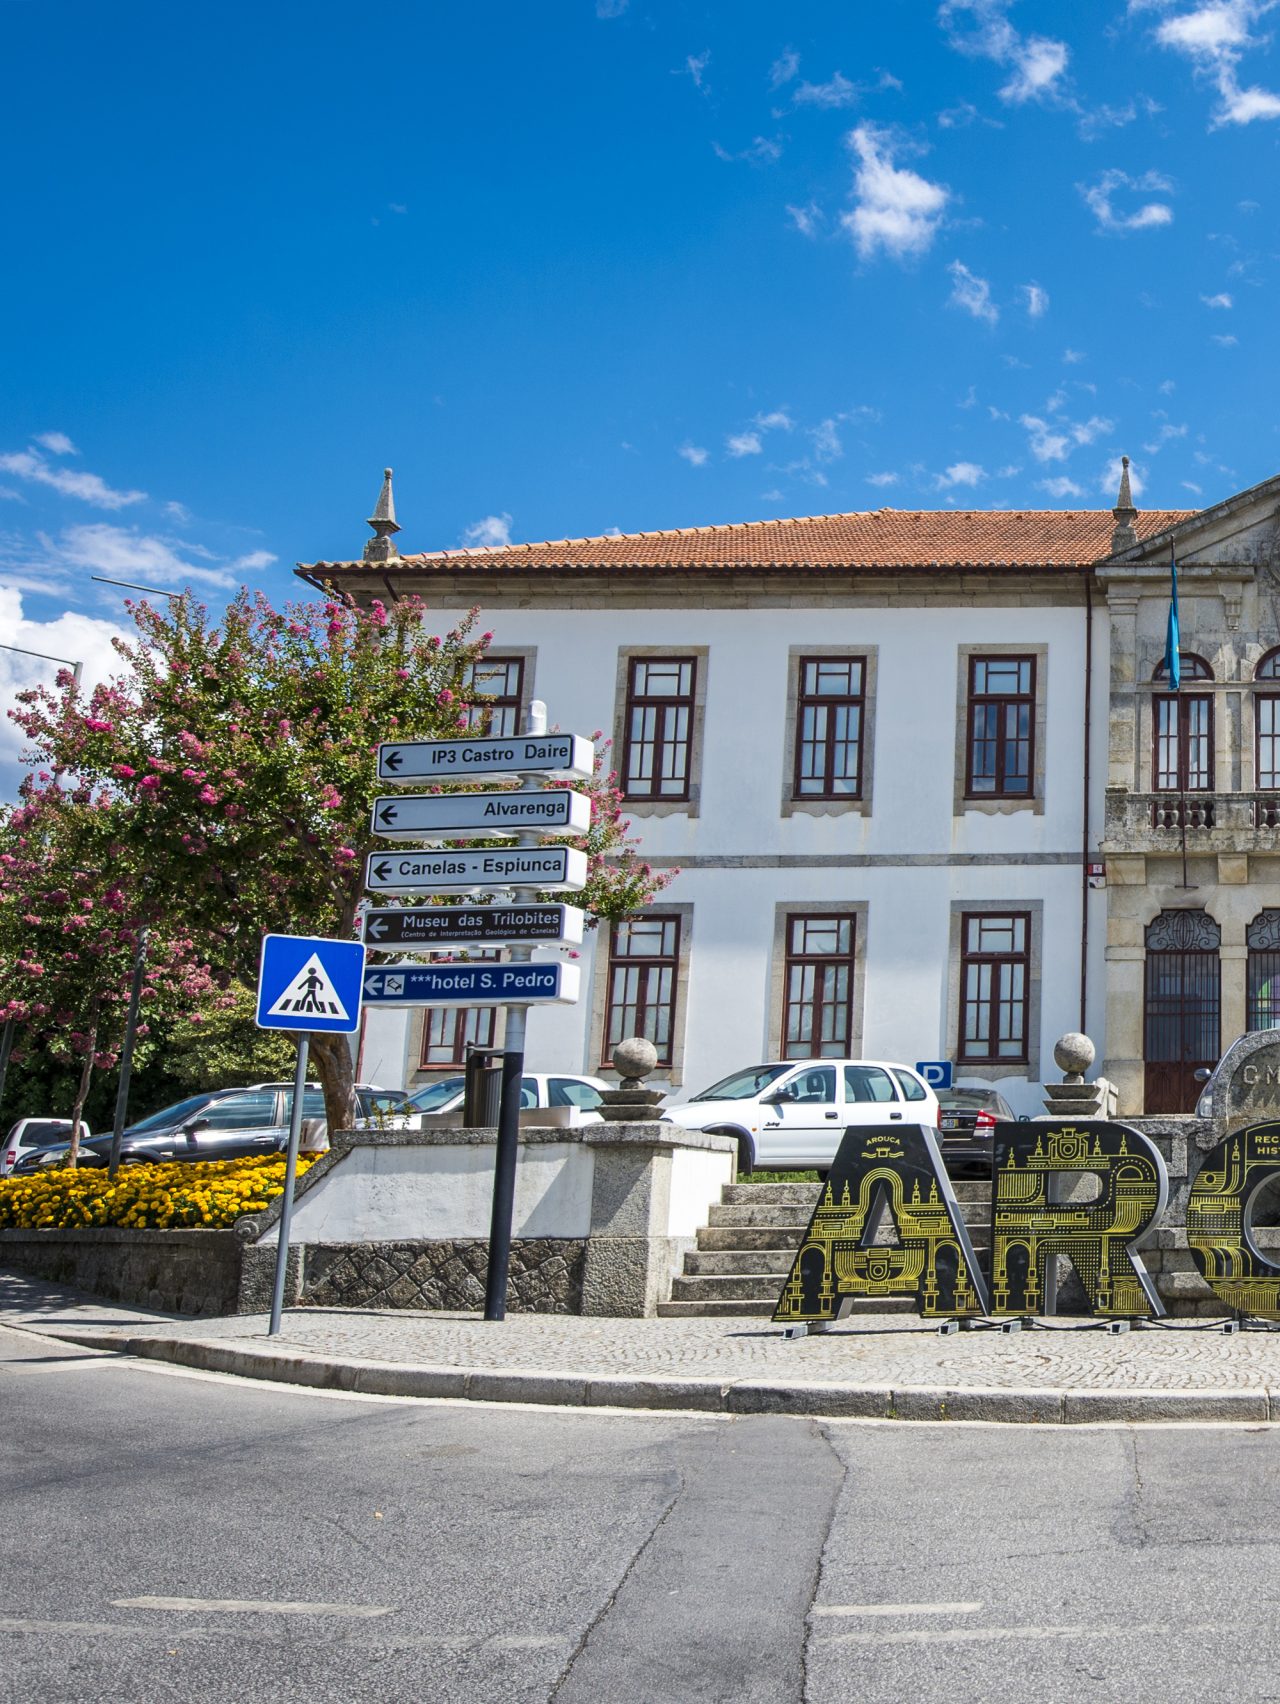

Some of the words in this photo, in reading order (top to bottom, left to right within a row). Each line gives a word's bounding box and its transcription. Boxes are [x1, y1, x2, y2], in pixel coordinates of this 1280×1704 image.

[432, 750, 457, 764] IP3
[462, 748, 514, 762] Castro
[524, 744, 568, 759] Daire
[484, 802, 565, 817] Alvarenga
[399, 860, 466, 876] Canelas
[483, 858, 561, 876] Espiunca
[403, 915, 449, 928] Museu
[458, 914, 483, 926] das
[492, 912, 559, 925] Trilobites
[480, 973, 497, 988] S.
[503, 972, 554, 988] Pedro
[866, 1136, 901, 1146] AROUCA
